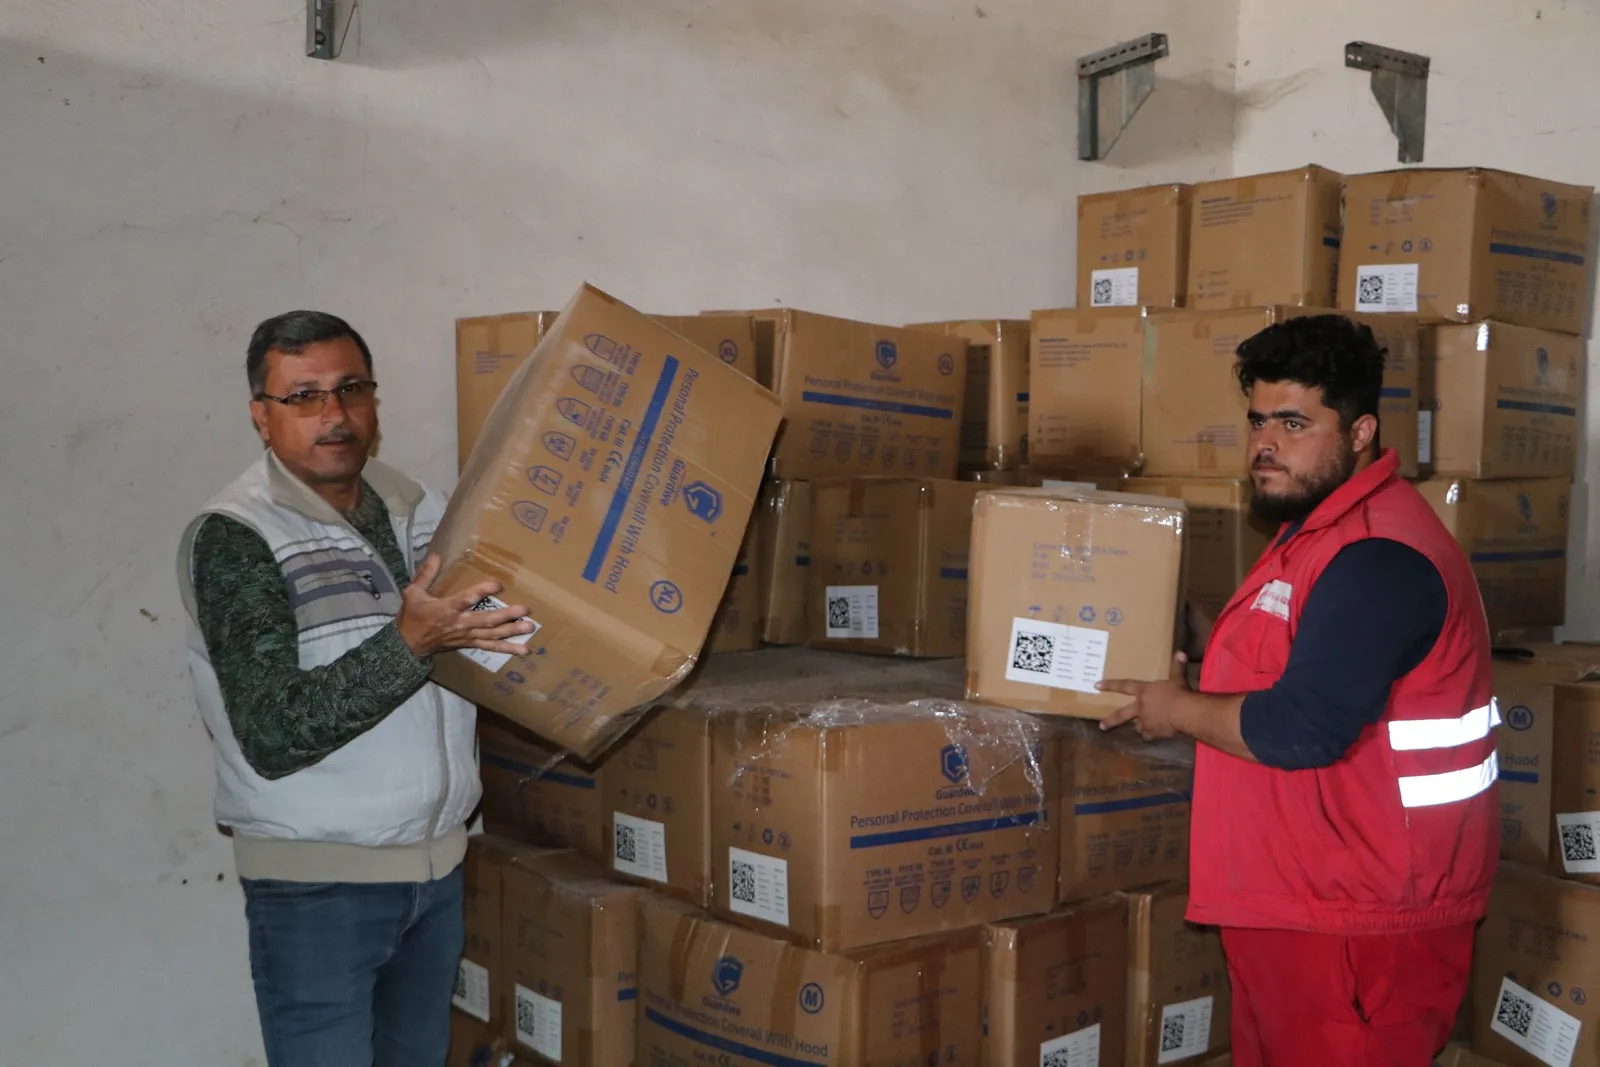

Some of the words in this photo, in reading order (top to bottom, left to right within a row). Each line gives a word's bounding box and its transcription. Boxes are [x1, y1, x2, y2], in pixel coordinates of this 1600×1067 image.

[671, 367, 700, 417] Personal
[650, 413, 684, 474] Protection
[631, 474, 661, 525] Coverall
[619, 524, 643, 555] With
[603, 554, 631, 595] Hood
[850, 810, 899, 828] Personal
[902, 806, 956, 822] Protection
[721, 1018, 763, 1041] Coverall
[765, 1030, 792, 1049] With
[795, 1039, 828, 1057] Hood
